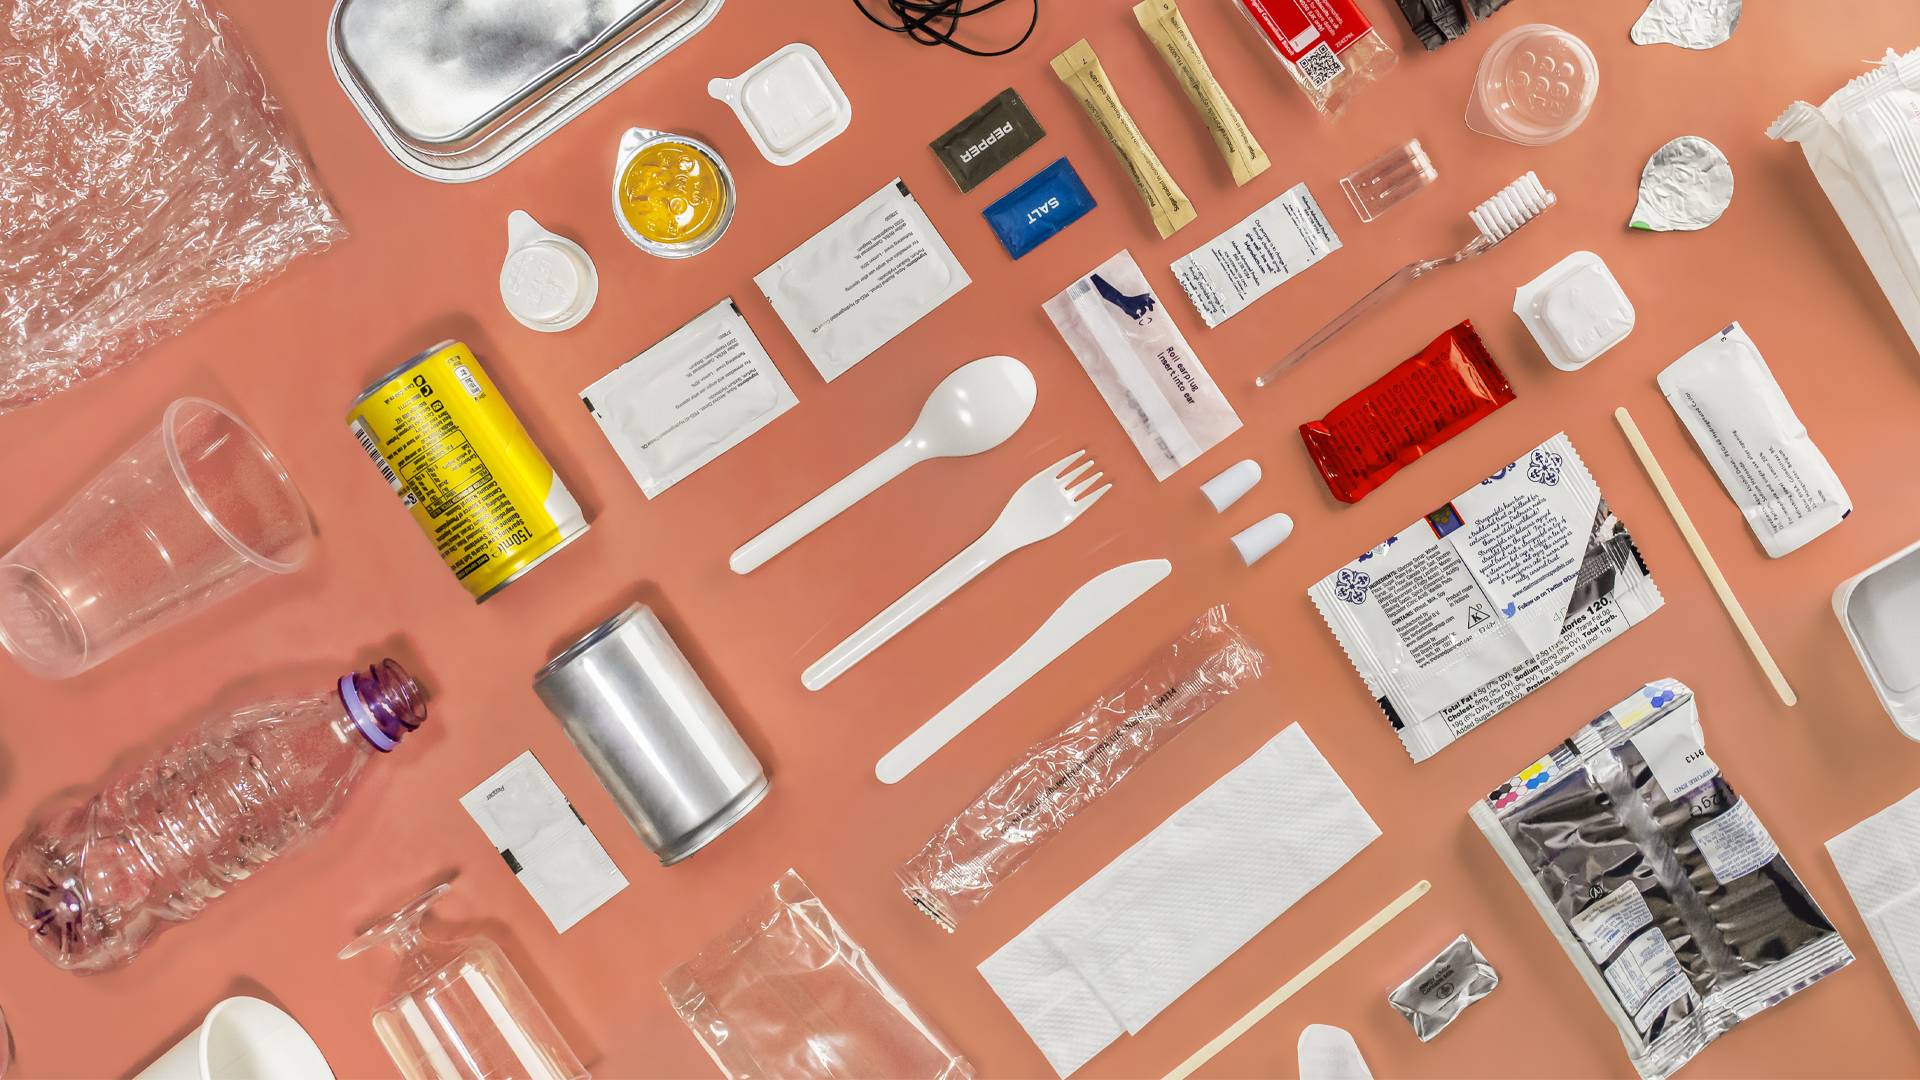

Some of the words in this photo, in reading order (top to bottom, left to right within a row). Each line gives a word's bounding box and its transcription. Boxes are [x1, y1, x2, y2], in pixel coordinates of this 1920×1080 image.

[958, 120, 1014, 164] PEPPER
[1023, 194, 1060, 226] SALT
[1166, 195, 1181, 212] Sugar
[1156, 351, 1177, 378] Insert
[1171, 374, 1187, 392] into
[1182, 391, 1195, 406] ear
[1165, 345, 1181, 363] Roll
[1175, 360, 1200, 393] earplug
[495, 523, 533, 555] 150ml
[1475, 602, 1483, 610] D
[1516, 598, 1534, 611] Follow
[1533, 594, 1541, 602] us
[1539, 590, 1548, 598] on
[1545, 579, 1564, 594] Twitter
[1470, 611, 1482, 623] K
[1557, 612, 1587, 635] alories
[1442, 701, 1461, 716] Total
[1460, 693, 1473, 705] Fat
[1472, 685, 1487, 699] 4.5g
[1523, 655, 1536, 667] Fat
[1534, 647, 1549, 661] 2.5g
[1575, 618, 1593, 633] Trans
[1590, 612, 1603, 623] Fat
[1446, 702, 1474, 723] Cholest.
[1473, 694, 1489, 707] 5mg
[1513, 662, 1540, 682] Sodium
[1556, 643, 1570, 656] (3%
[1581, 623, 1600, 638] Total
[1598, 611, 1618, 627] Carb.
[1451, 718, 1464, 730] 19g
[1488, 692, 1505, 707] Fiber
[1503, 687, 1514, 698] 0g
[1539, 662, 1555, 675] Total
[1553, 649, 1575, 667] Sugars
[1573, 642, 1587, 654] 11g
[1599, 625, 1612, 637] 11g
[1454, 720, 1475, 736] Added
[1525, 673, 1550, 693] Protein
[1683, 748, 1705, 764] 9113
[1672, 782, 1688, 794] END
[1687, 767, 1714, 785] BEFORE
